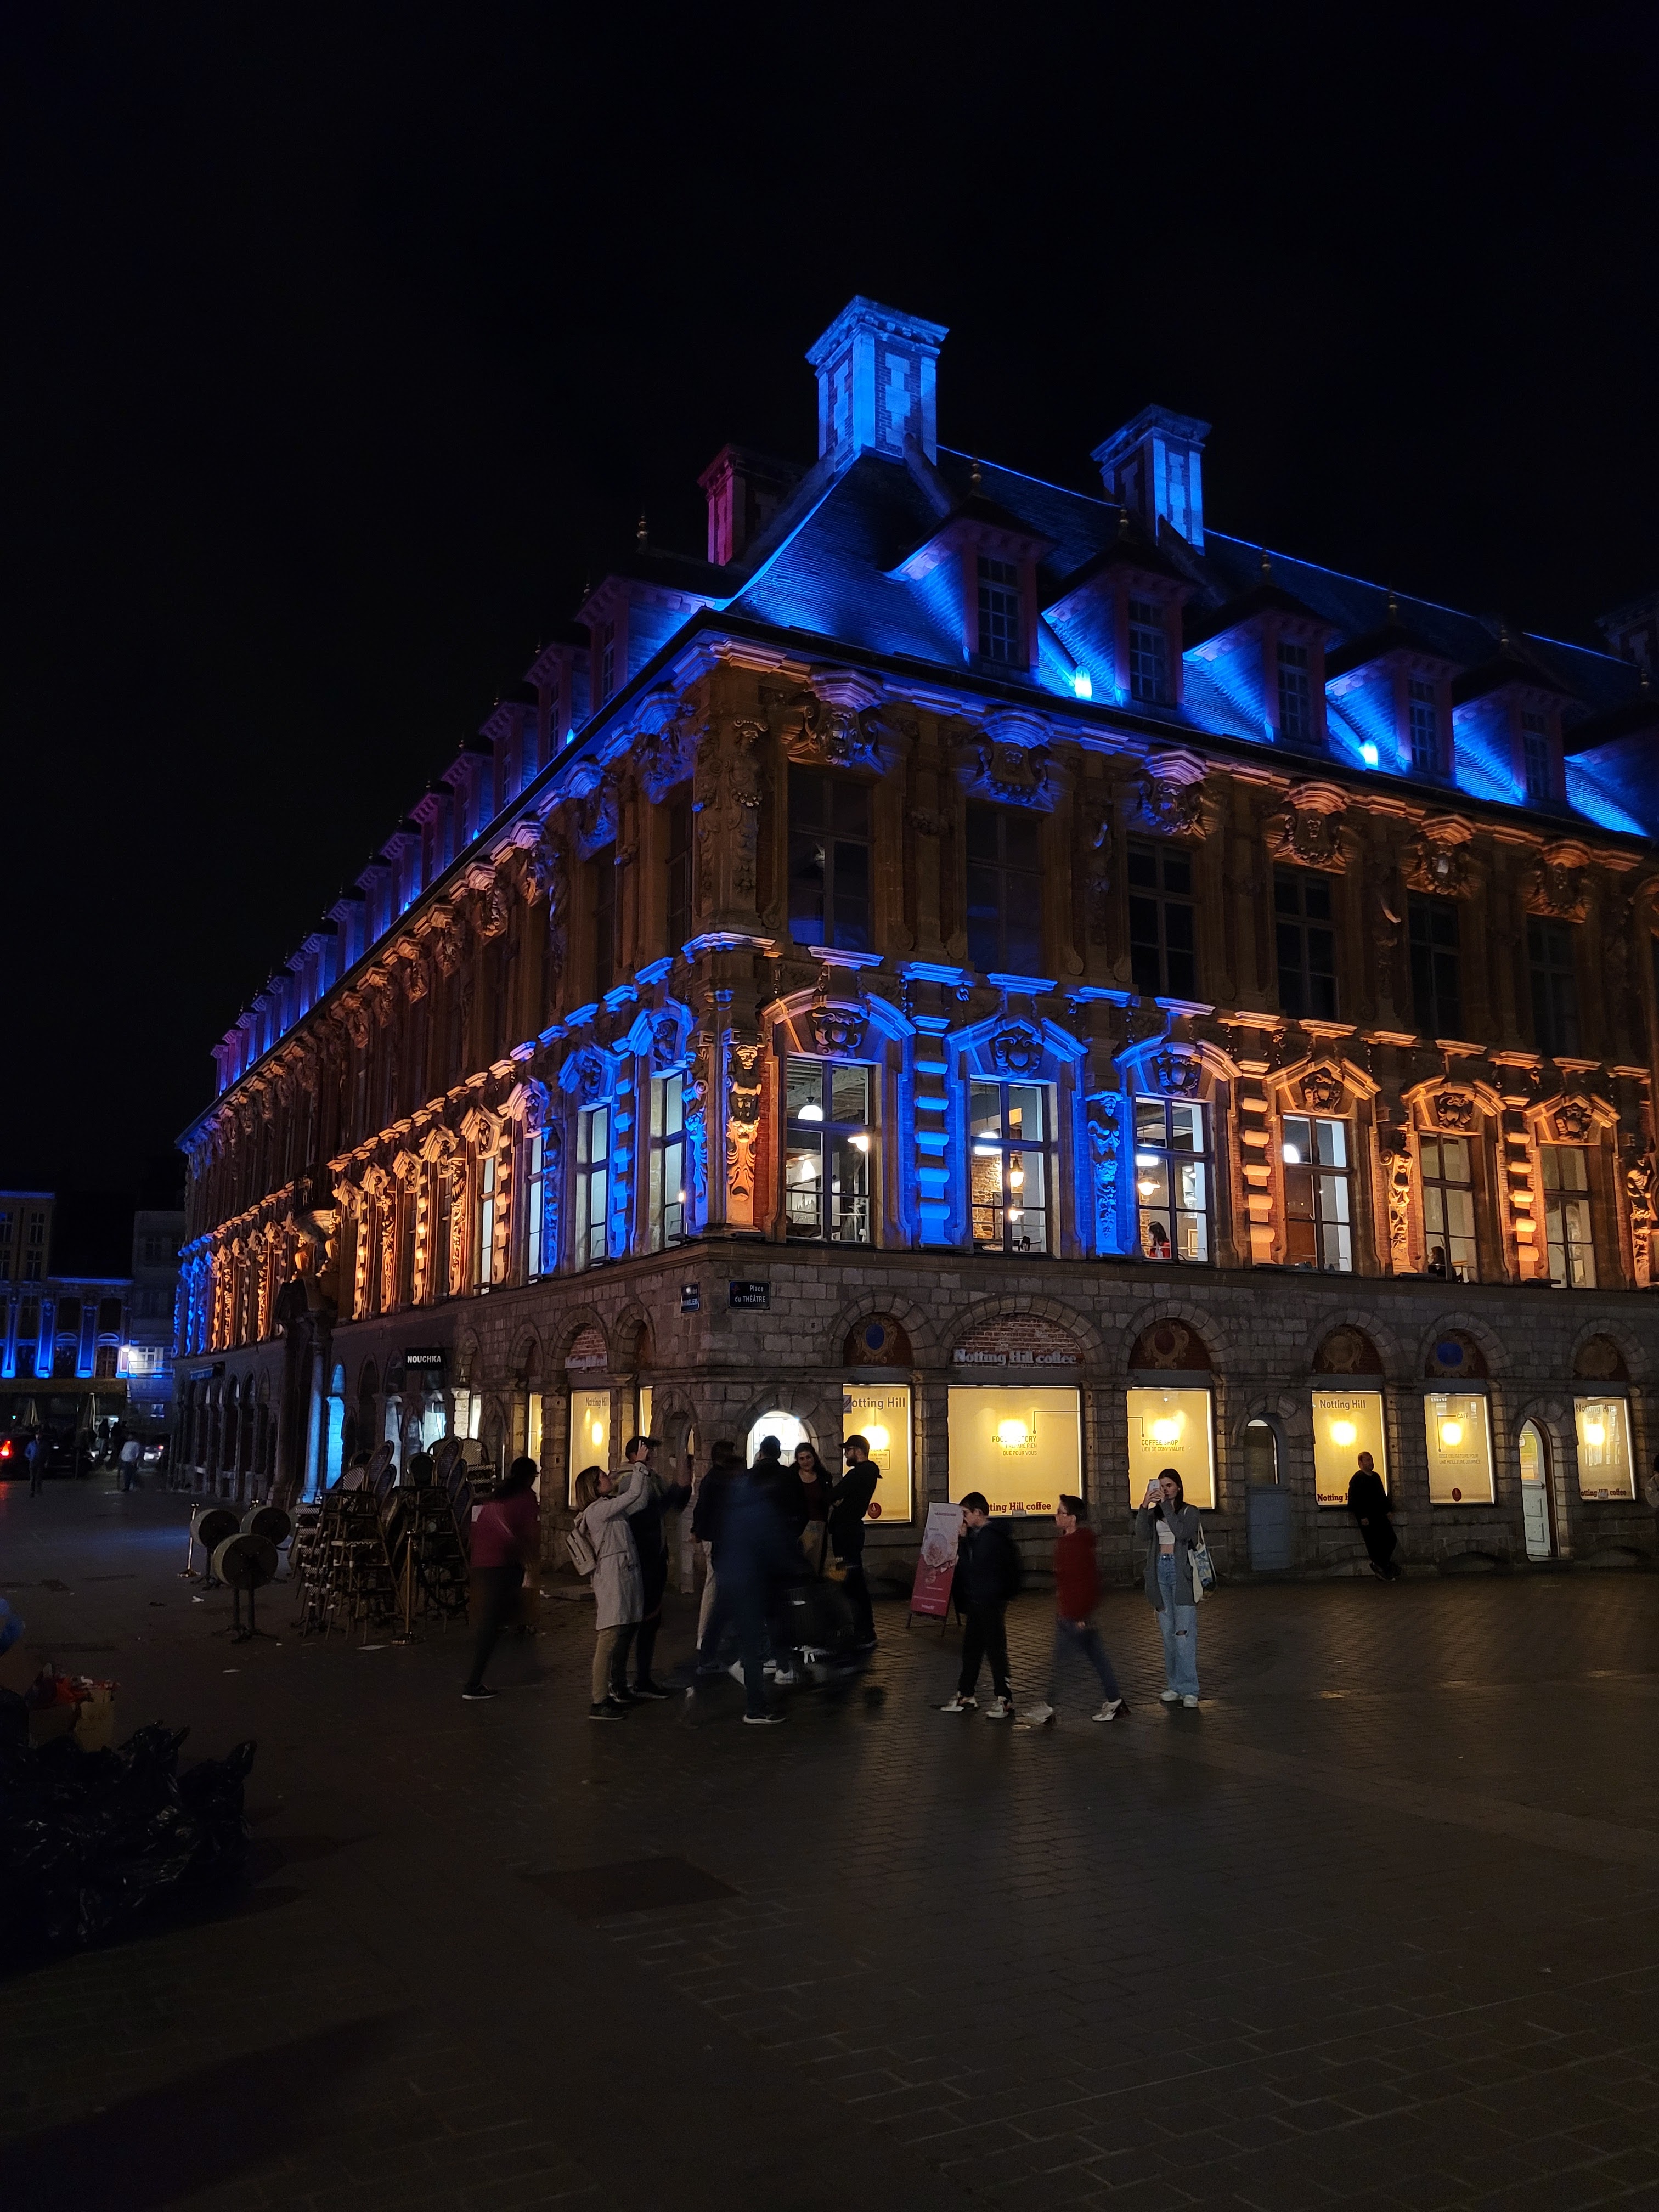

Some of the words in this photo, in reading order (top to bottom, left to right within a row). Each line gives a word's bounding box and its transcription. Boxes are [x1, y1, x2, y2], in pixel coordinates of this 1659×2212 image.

[407, 1355, 441, 1363] NOUCHKA
[953, 1348, 1006, 1365] Notting
[1009, 1350, 1034, 1363] Hill
[1035, 1350, 1076, 1364] coffee
[585, 1397, 601, 1408] Notting
[852, 1397, 884, 1410] otting
[887, 1397, 905, 1408] Hill
[1319, 1399, 1350, 1411] Notting
[1352, 1400, 1365, 1409] Hill
[1317, 1493, 1344, 1502] Notting
[1581, 1489, 1597, 1497] otting
[1009, 1502, 1024, 1510] Hill
[1026, 1501, 1051, 1510] coffee
